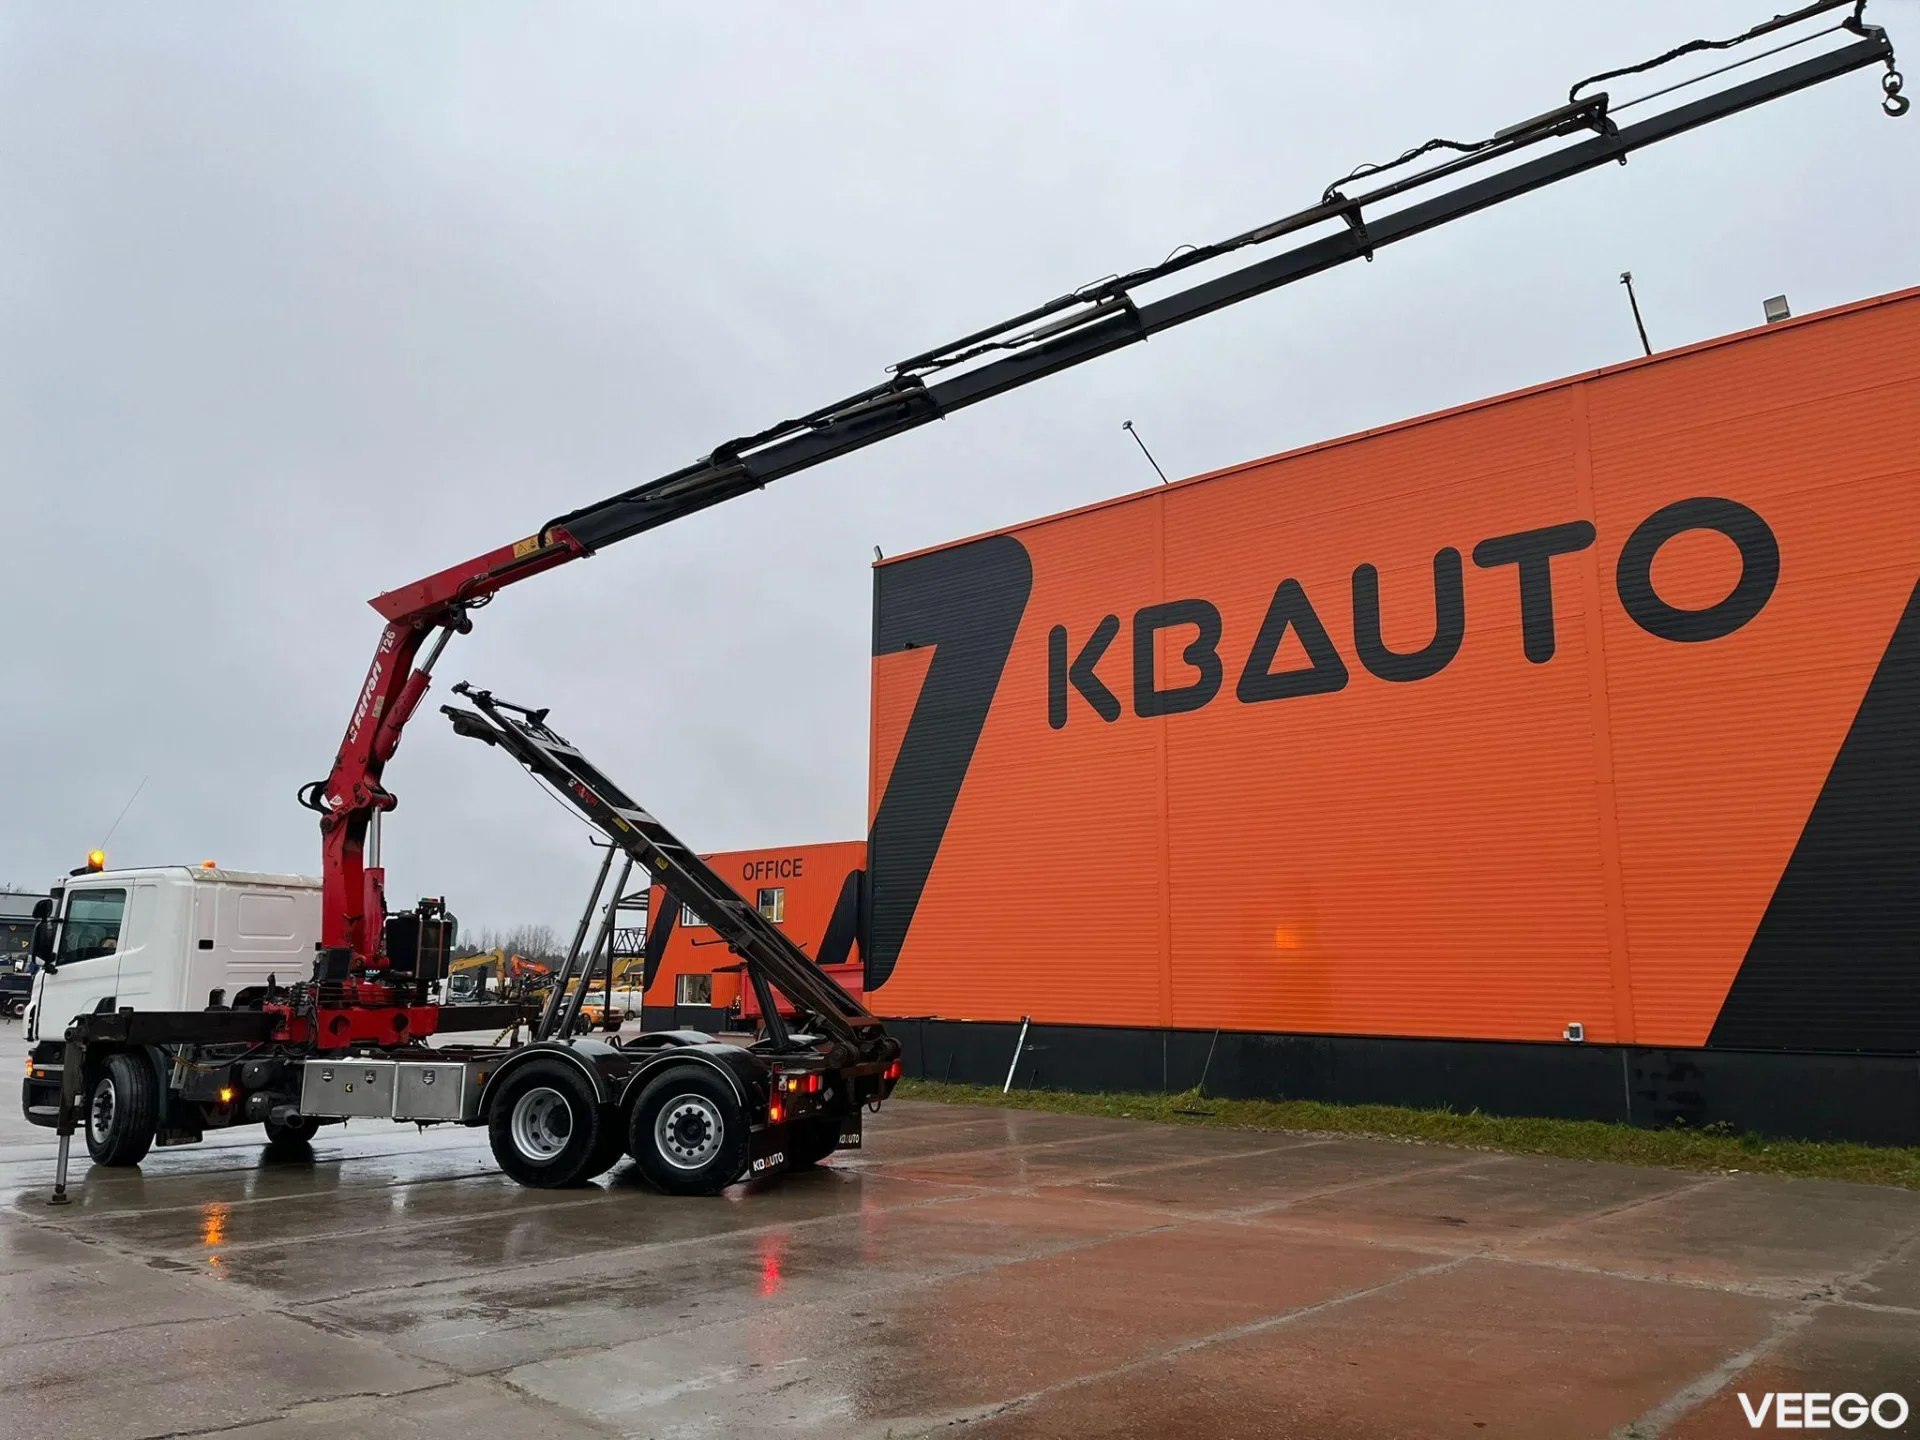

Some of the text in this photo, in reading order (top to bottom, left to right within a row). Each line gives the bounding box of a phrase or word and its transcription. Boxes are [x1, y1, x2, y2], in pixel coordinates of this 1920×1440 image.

[1048, 496, 1781, 730] KBAUTO
[380, 630, 396, 654] 726
[742, 858, 803, 881] OFFICE
[752, 1152, 784, 1172] KBAUTO
